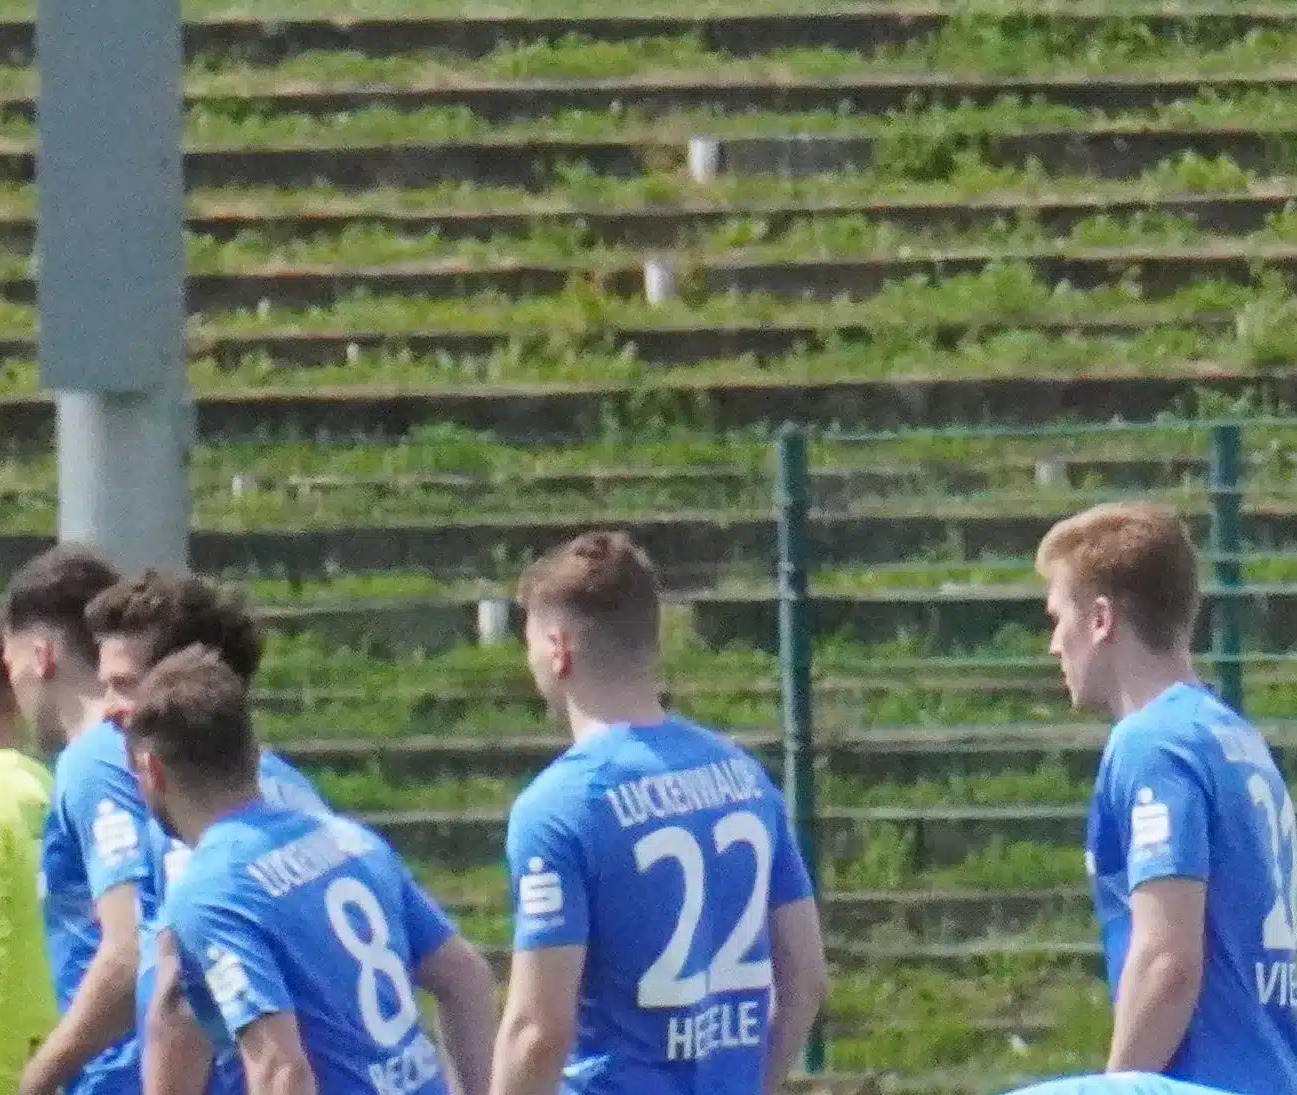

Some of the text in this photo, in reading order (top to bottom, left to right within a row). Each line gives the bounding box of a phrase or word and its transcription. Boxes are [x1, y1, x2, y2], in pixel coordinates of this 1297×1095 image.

[325, 876, 419, 1047] 8
[633, 810, 774, 1009] 22
[665, 1000, 760, 1063] HEELE
